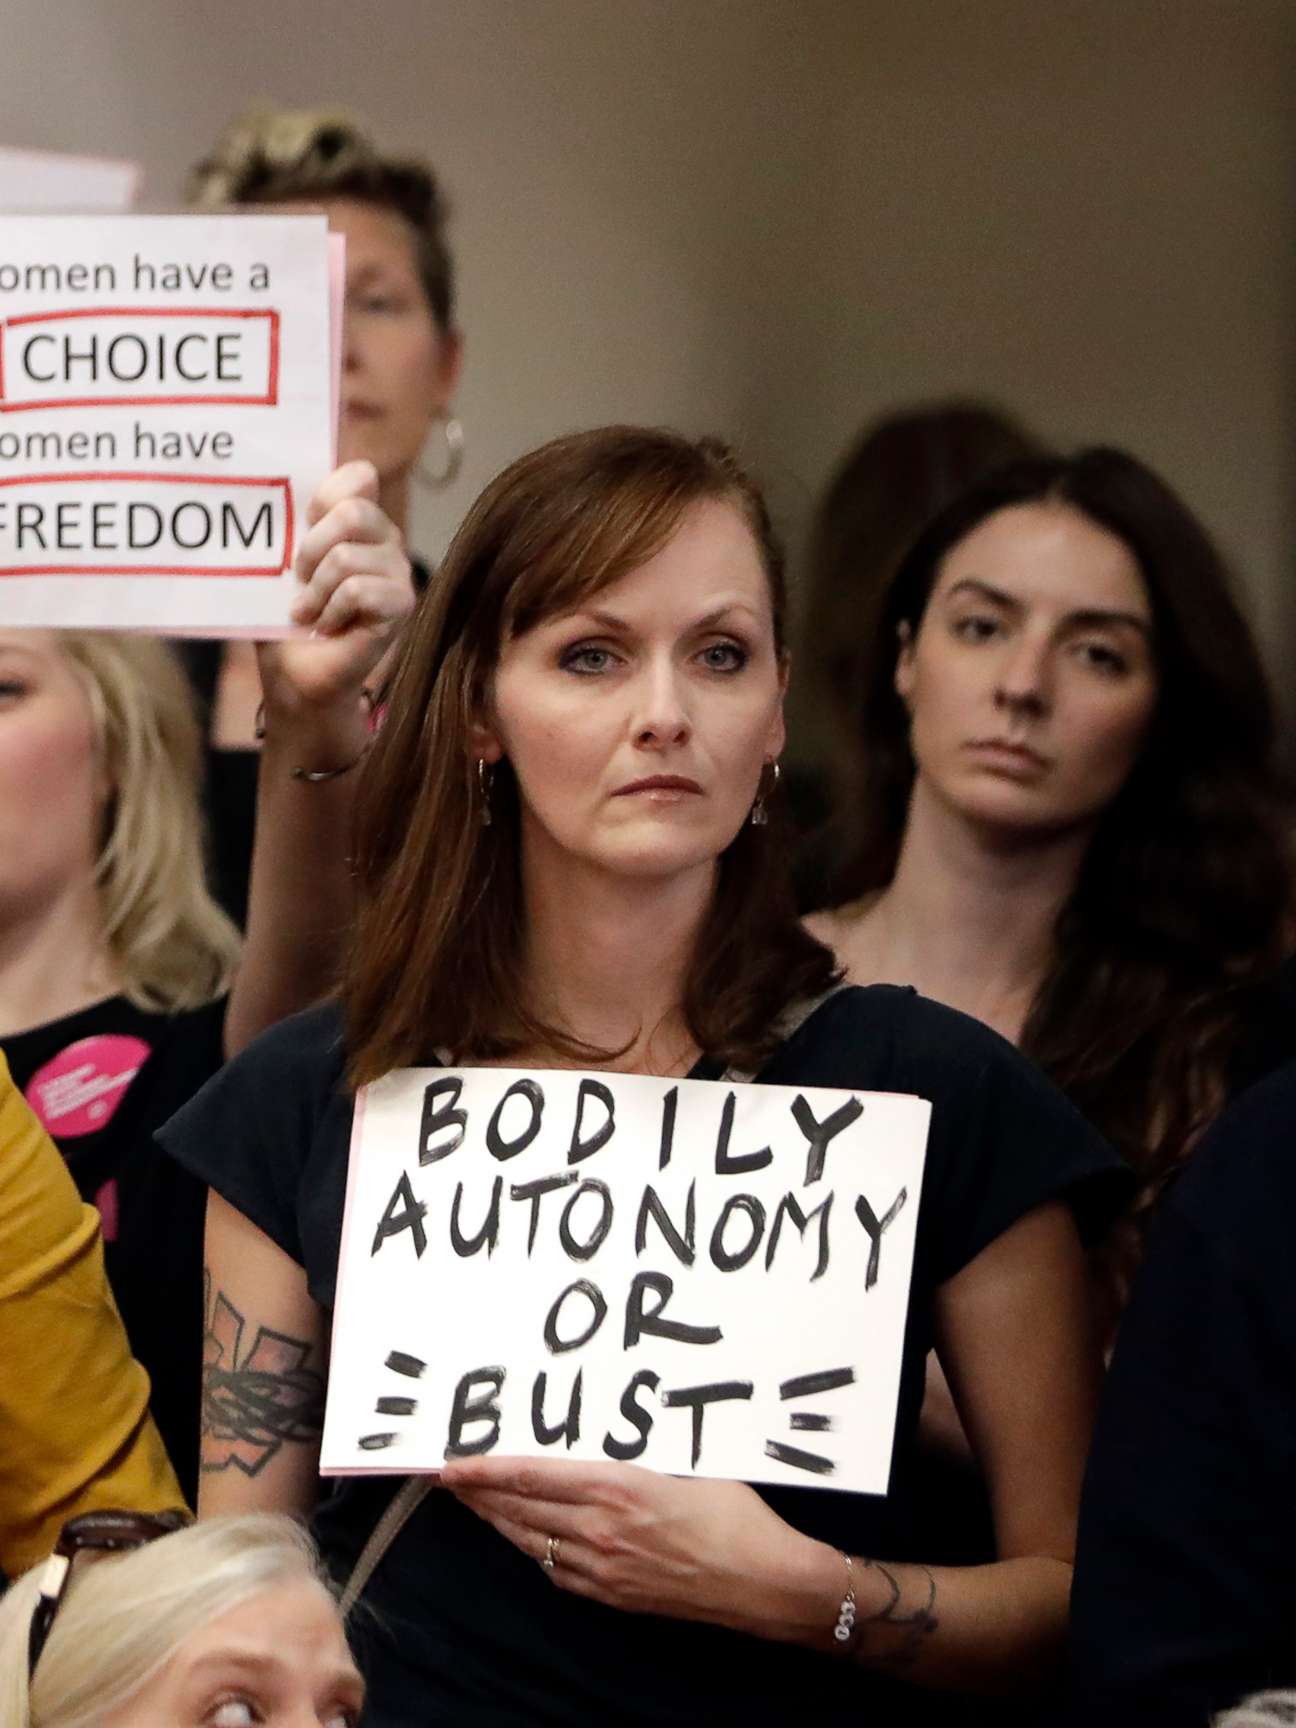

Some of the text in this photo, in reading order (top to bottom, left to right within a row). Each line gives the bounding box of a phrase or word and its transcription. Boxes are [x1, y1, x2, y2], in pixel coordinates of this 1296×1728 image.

[133, 253, 234, 292] have
[248, 263, 271, 292] a
[21, 332, 243, 384] CHOICE
[133, 422, 234, 460] have
[418, 1076, 865, 1187] BODILY
[370, 1169, 908, 1293] AUTONOMY
[543, 1271, 724, 1354] OR
[443, 1366, 754, 1470] BUST
